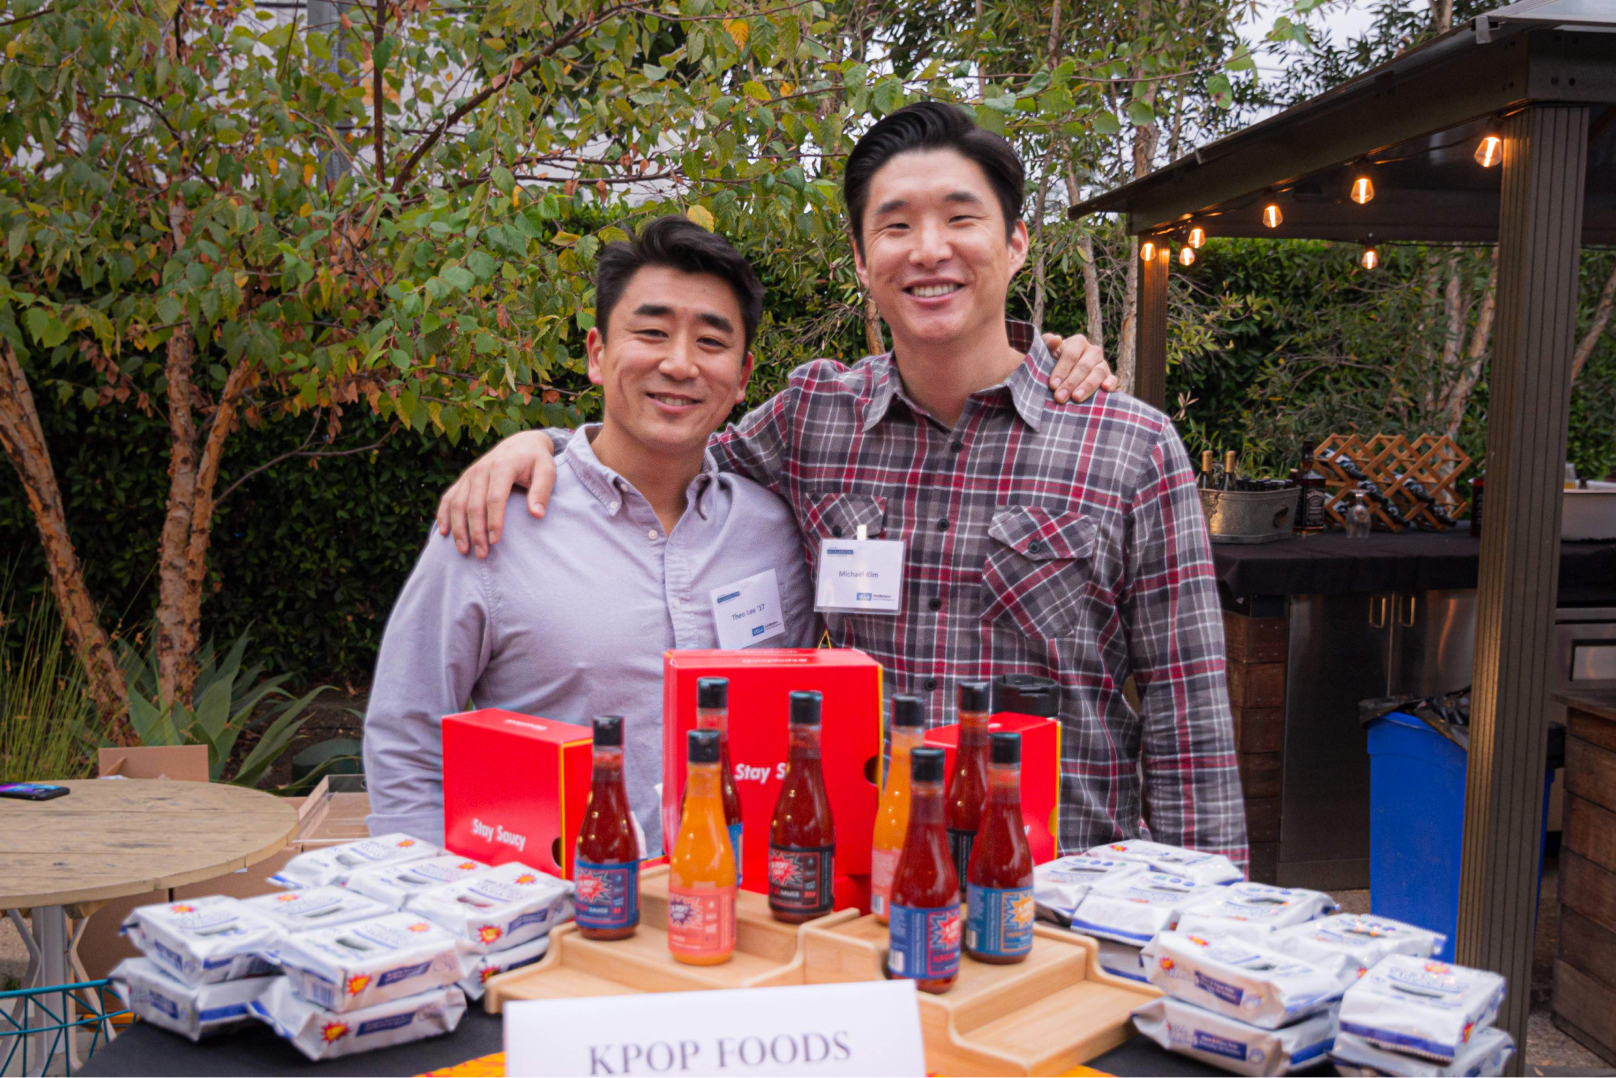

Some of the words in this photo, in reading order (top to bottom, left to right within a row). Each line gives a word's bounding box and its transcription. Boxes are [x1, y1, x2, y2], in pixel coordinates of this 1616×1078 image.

[839, 570, 864, 578] Michael
[732, 611, 746, 621] Theo
[746, 607, 757, 616] Lee
[756, 603, 765, 612] '17
[735, 762, 771, 784] Stay
[473, 818, 494, 843] Stay
[496, 825, 526, 852] Saucy
[588, 1040, 701, 1076] KPOP
[716, 1030, 851, 1068] FOODS
